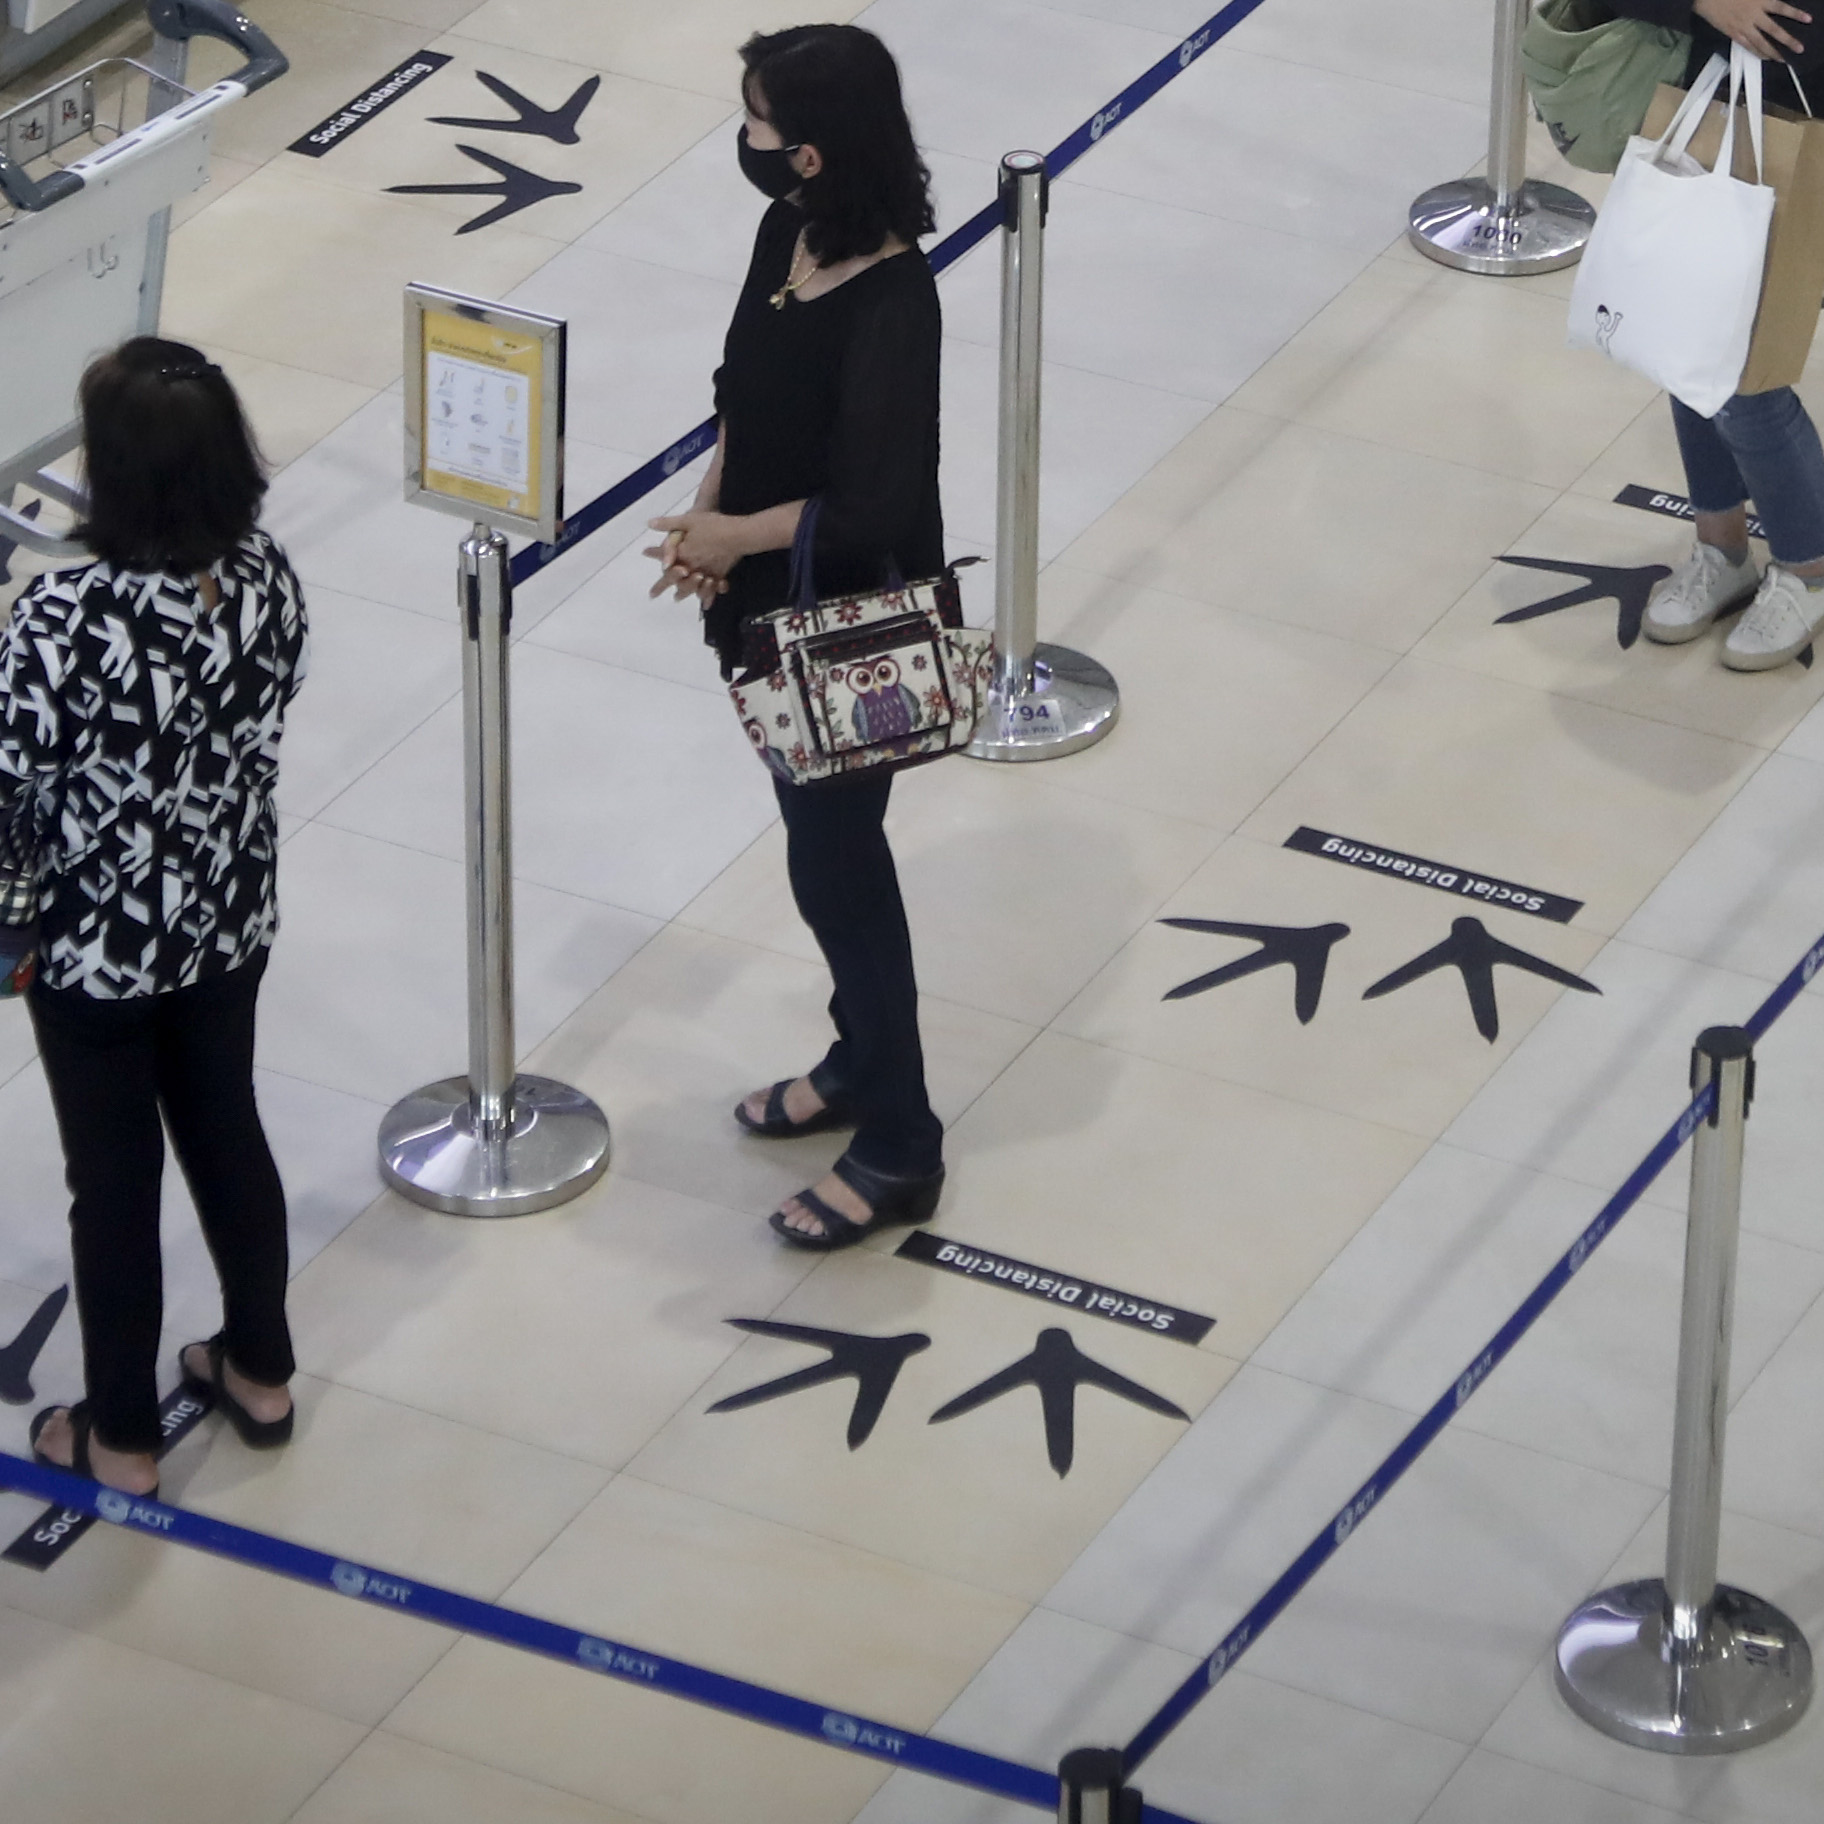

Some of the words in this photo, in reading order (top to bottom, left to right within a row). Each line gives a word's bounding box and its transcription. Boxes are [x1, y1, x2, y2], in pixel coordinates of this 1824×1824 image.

[310, 109, 361, 145] Social
[350, 62, 433, 114] Distancing
[1321, 837, 1459, 889] Distancing
[1462, 879, 1546, 913] Social
[935, 1243, 1082, 1306] Distancing
[1086, 1286, 1175, 1332] Social
[129, 1505, 175, 1531] AOT
[366, 1578, 412, 1604] AOT
[612, 1651, 659, 1680] AOT
[857, 1729, 906, 1756] AOT
